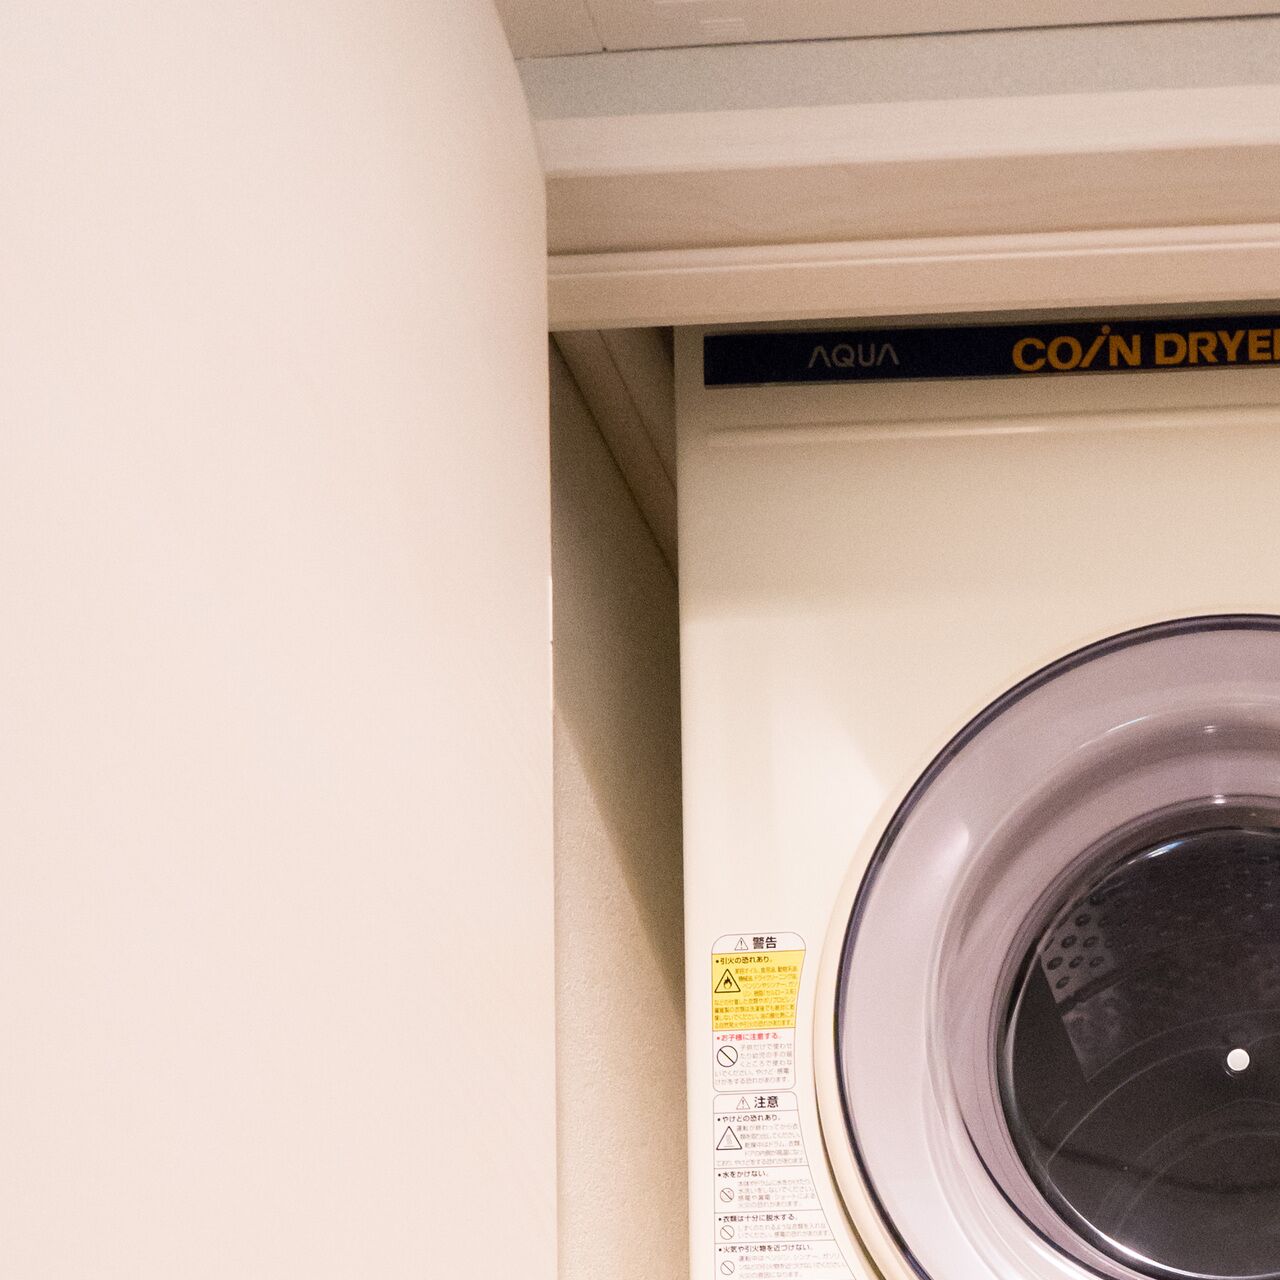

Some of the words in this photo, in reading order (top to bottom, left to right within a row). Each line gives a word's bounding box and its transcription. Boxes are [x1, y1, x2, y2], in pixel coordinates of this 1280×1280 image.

[807, 343, 900, 368] AQUA
[1012, 325, 1142, 372] COIN
[752, 936, 778, 950] 警告
[754, 1096, 779, 1109] 注意
